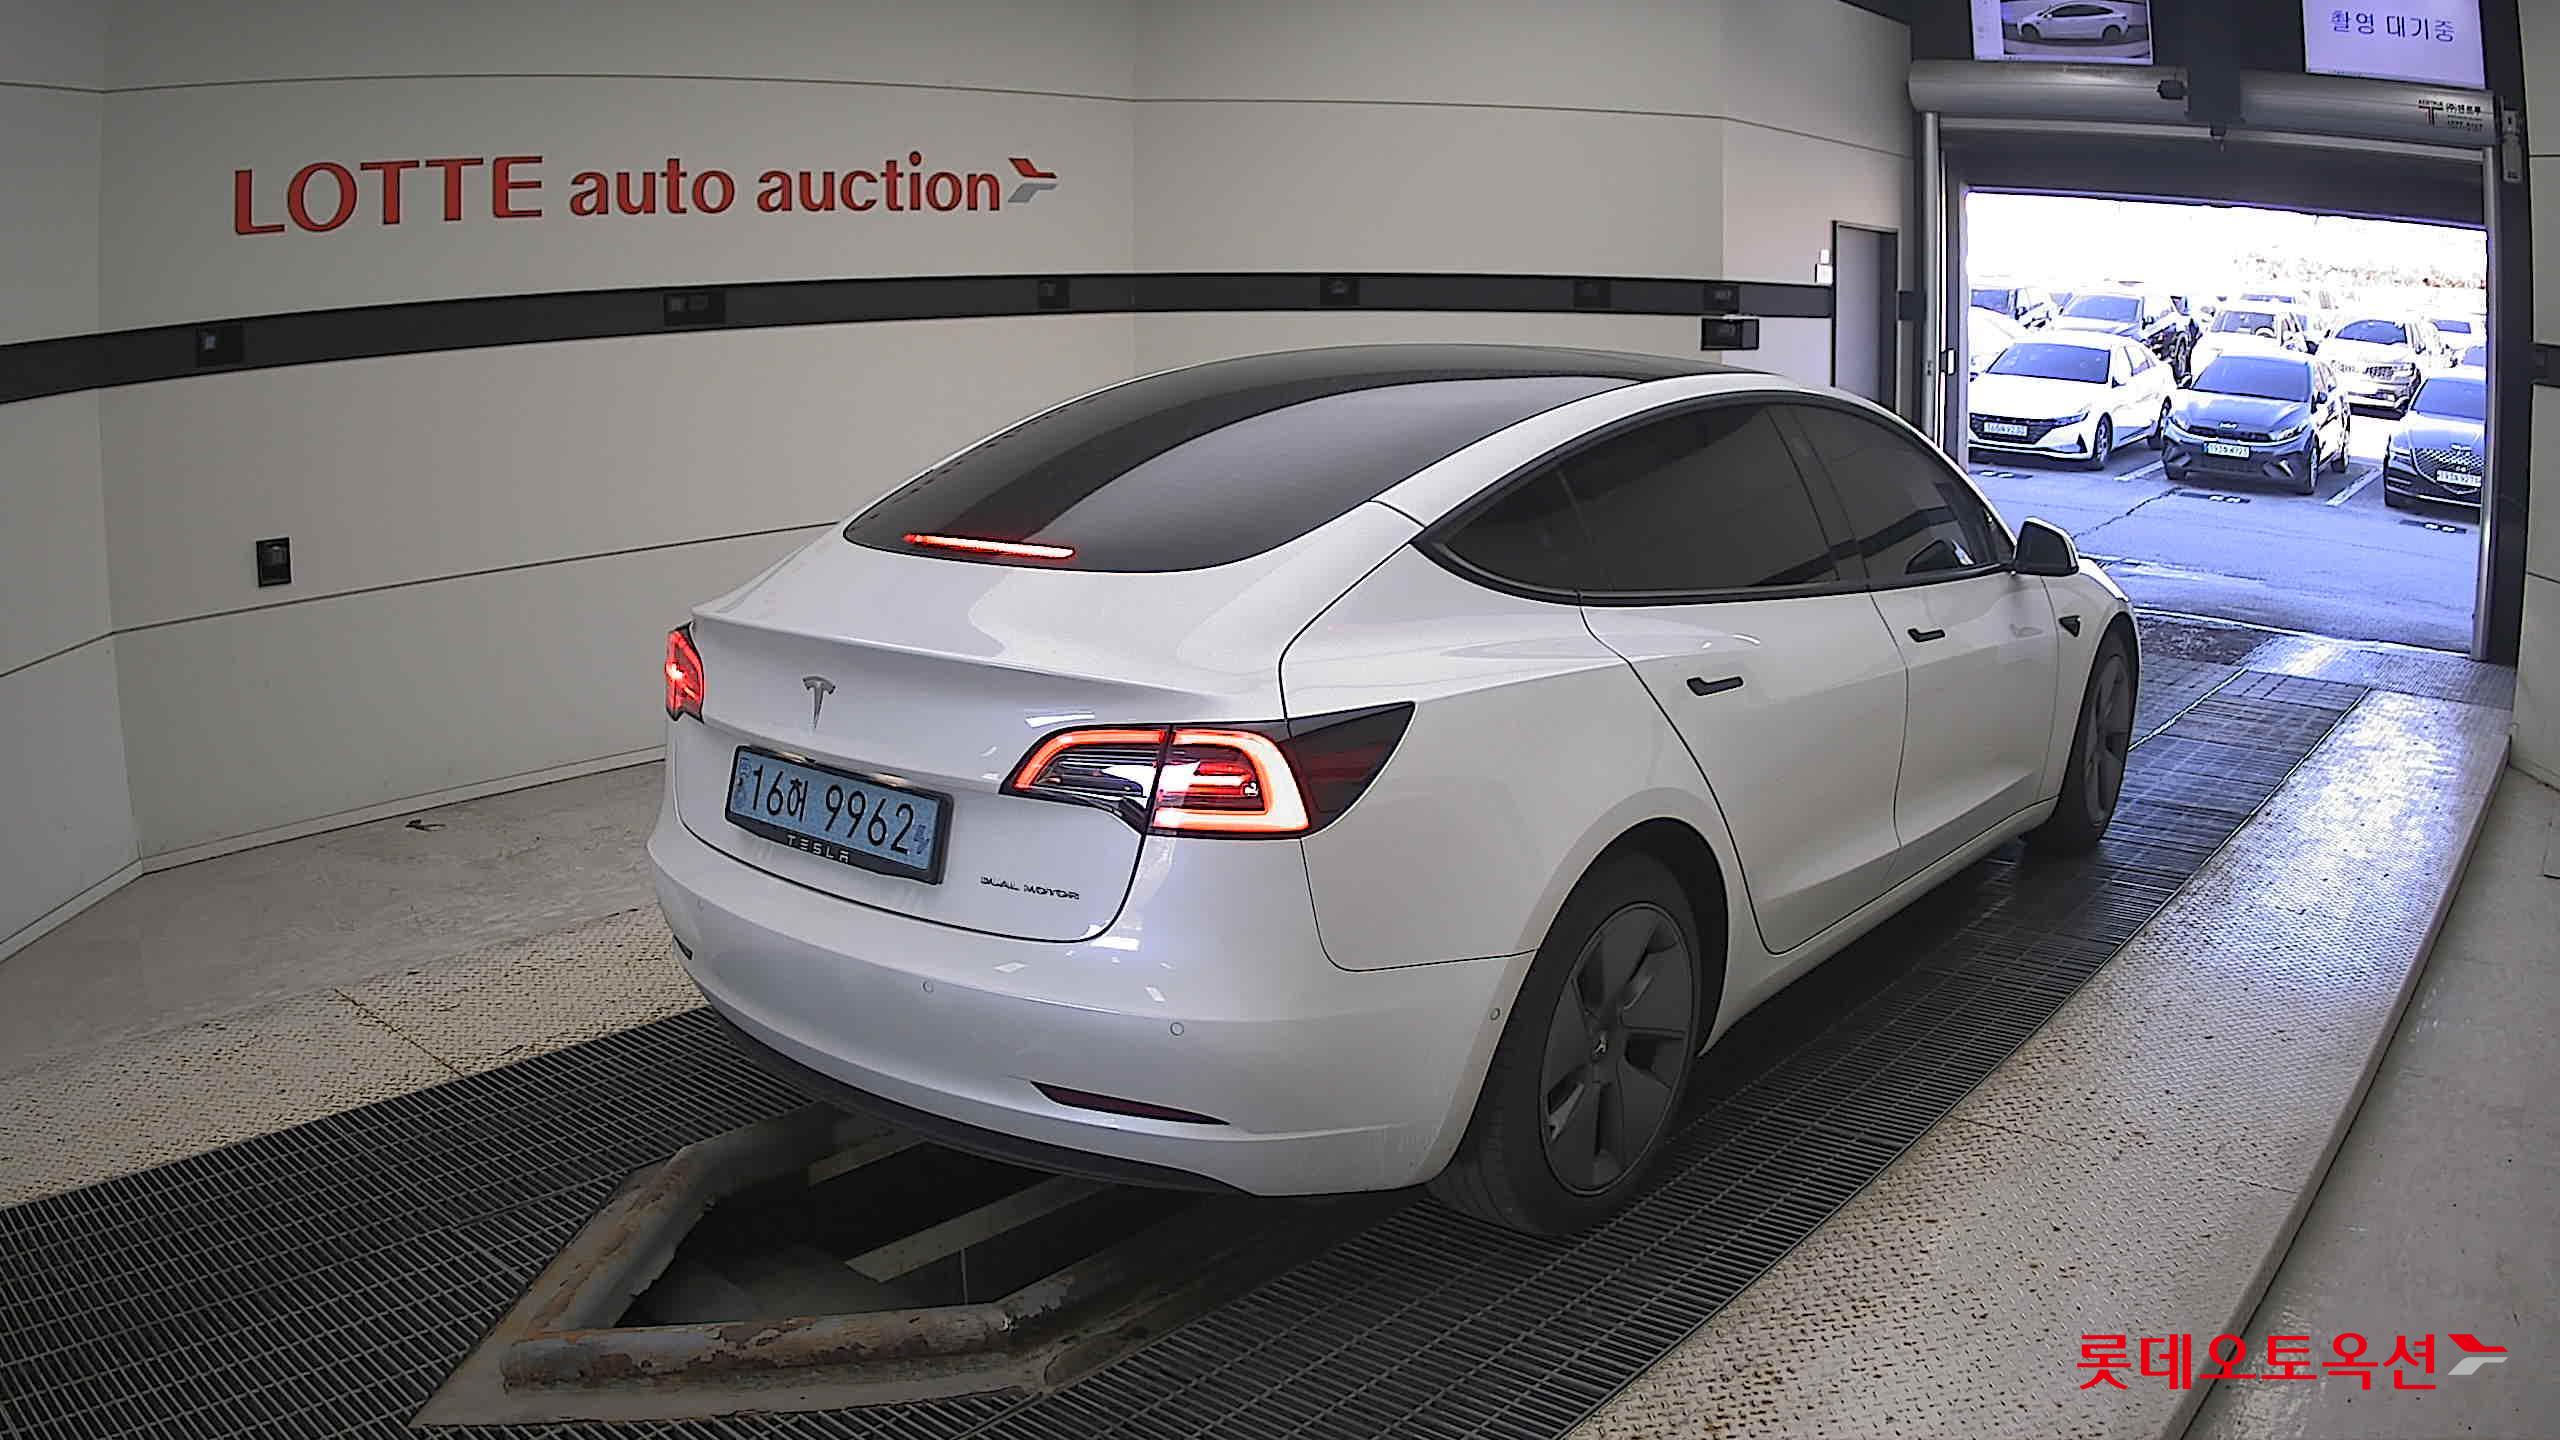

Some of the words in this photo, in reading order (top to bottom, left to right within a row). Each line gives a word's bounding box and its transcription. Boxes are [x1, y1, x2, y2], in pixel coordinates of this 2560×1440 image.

[2331, 10, 2375, 35] 촬영
[2386, 15, 2455, 43] 대기중
[235, 155, 543, 235] LOTTE
[570, 158, 736, 216] auto
[758, 150, 1002, 215] auction
[753, 764, 808, 822] 16허
[825, 784, 914, 855] 9962
[787, 834, 849, 864] TESLA
[980, 876, 1020, 891] DUAL
[1023, 884, 1080, 900] MOTOR
